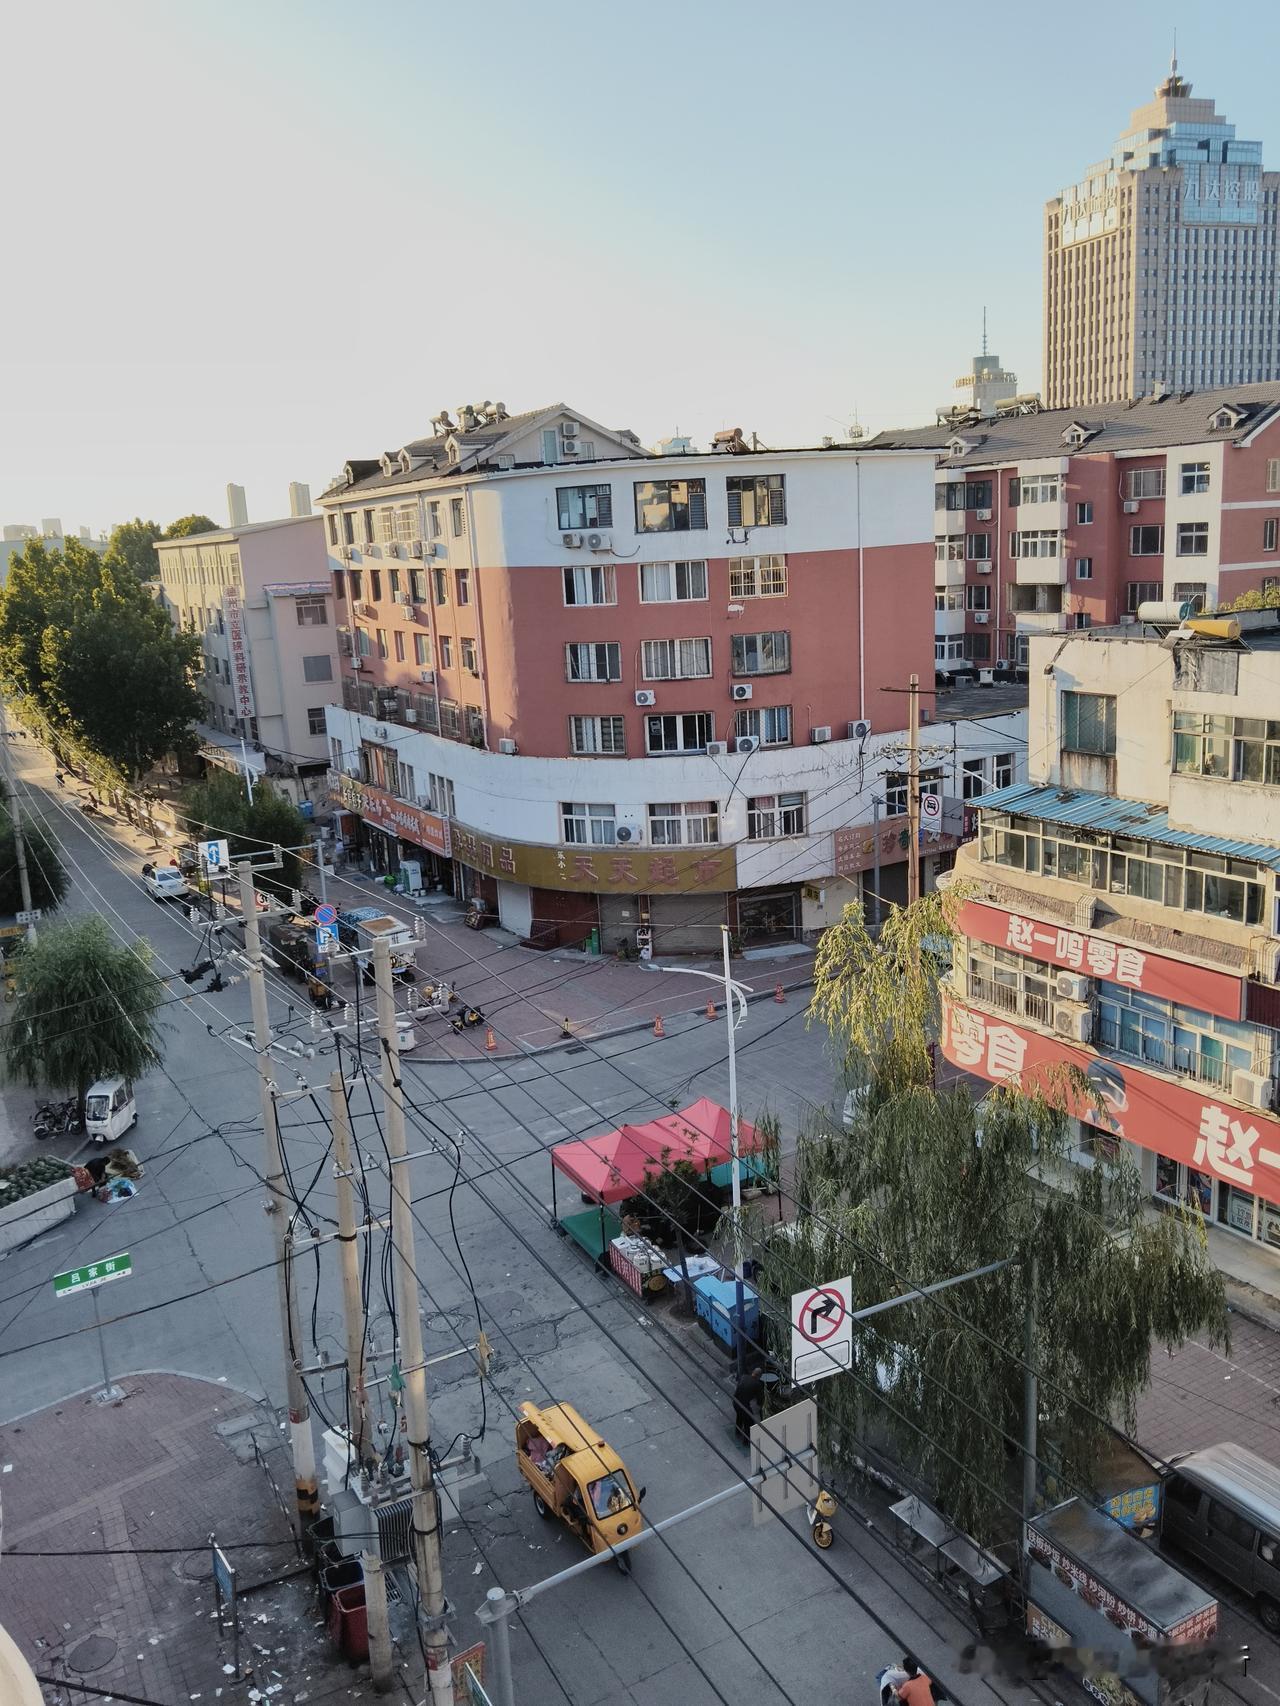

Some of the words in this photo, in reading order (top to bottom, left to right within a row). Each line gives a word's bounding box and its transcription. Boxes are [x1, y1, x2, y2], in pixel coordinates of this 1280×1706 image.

[1184, 179, 1259, 201] 九达控股
[570, 855, 722, 884] 天天超市
[1006, 914, 1147, 988] 赵一鸣零食
[942, 1003, 1028, 1086] 零食
[71, 1261, 115, 1284] 吕家街
[1027, 1529, 1060, 1563] 铁板炒饭
[1062, 1557, 1087, 1585] 炒米线
[1089, 1578, 1116, 1609] 炒河粉
[1117, 1601, 1137, 1625] 炒饼
[1138, 1617, 1158, 1639] 炒面
